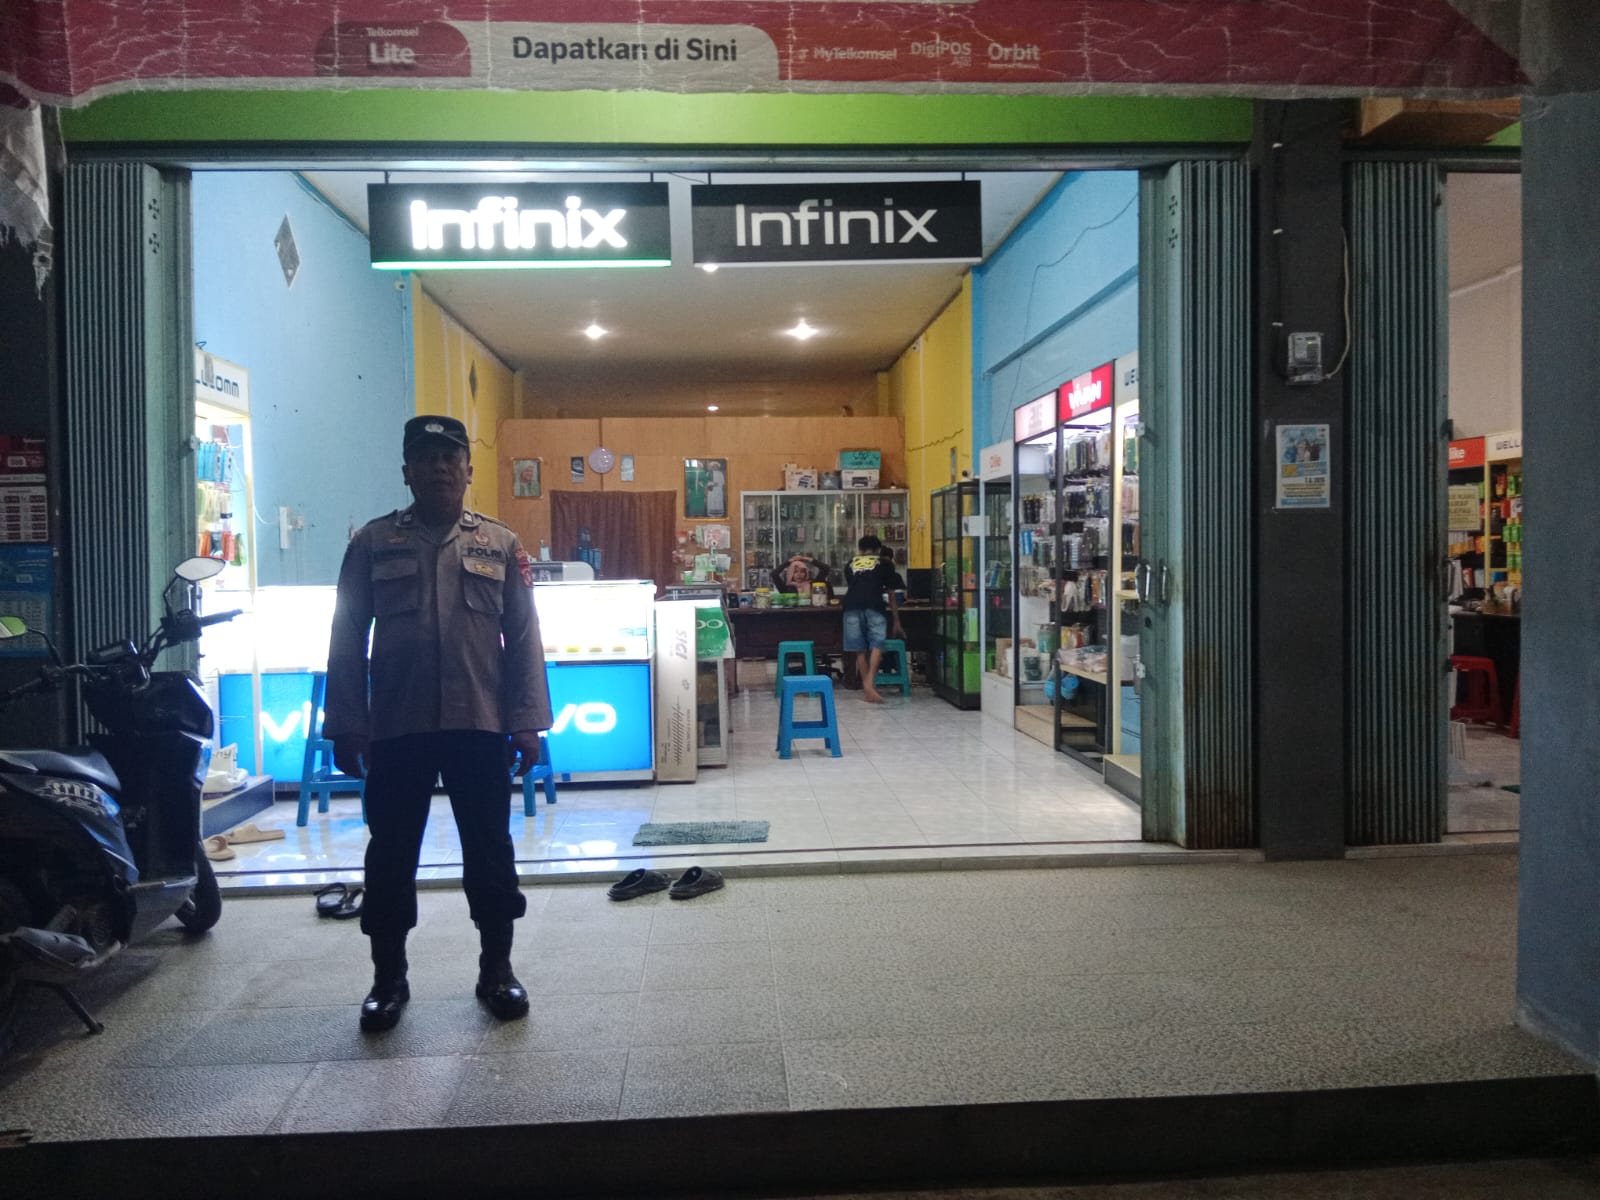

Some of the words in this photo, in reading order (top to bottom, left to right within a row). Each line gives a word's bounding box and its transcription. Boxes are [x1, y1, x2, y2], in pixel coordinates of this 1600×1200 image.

[367, 27, 419, 38] Telkomsel
[369, 43, 415, 66] Lite
[513, 36, 648, 65] Dapatkan
[655, 37, 680, 61] di
[687, 37, 738, 62] Sini
[813, 47, 897, 61] MyTelkomsel
[910, 41, 972, 58] DigiPOS
[987, 41, 1041, 61] Orbit
[409, 195, 629, 251] Infinix
[734, 199, 939, 248] Infinix
[467, 546, 502, 558] POLRI
